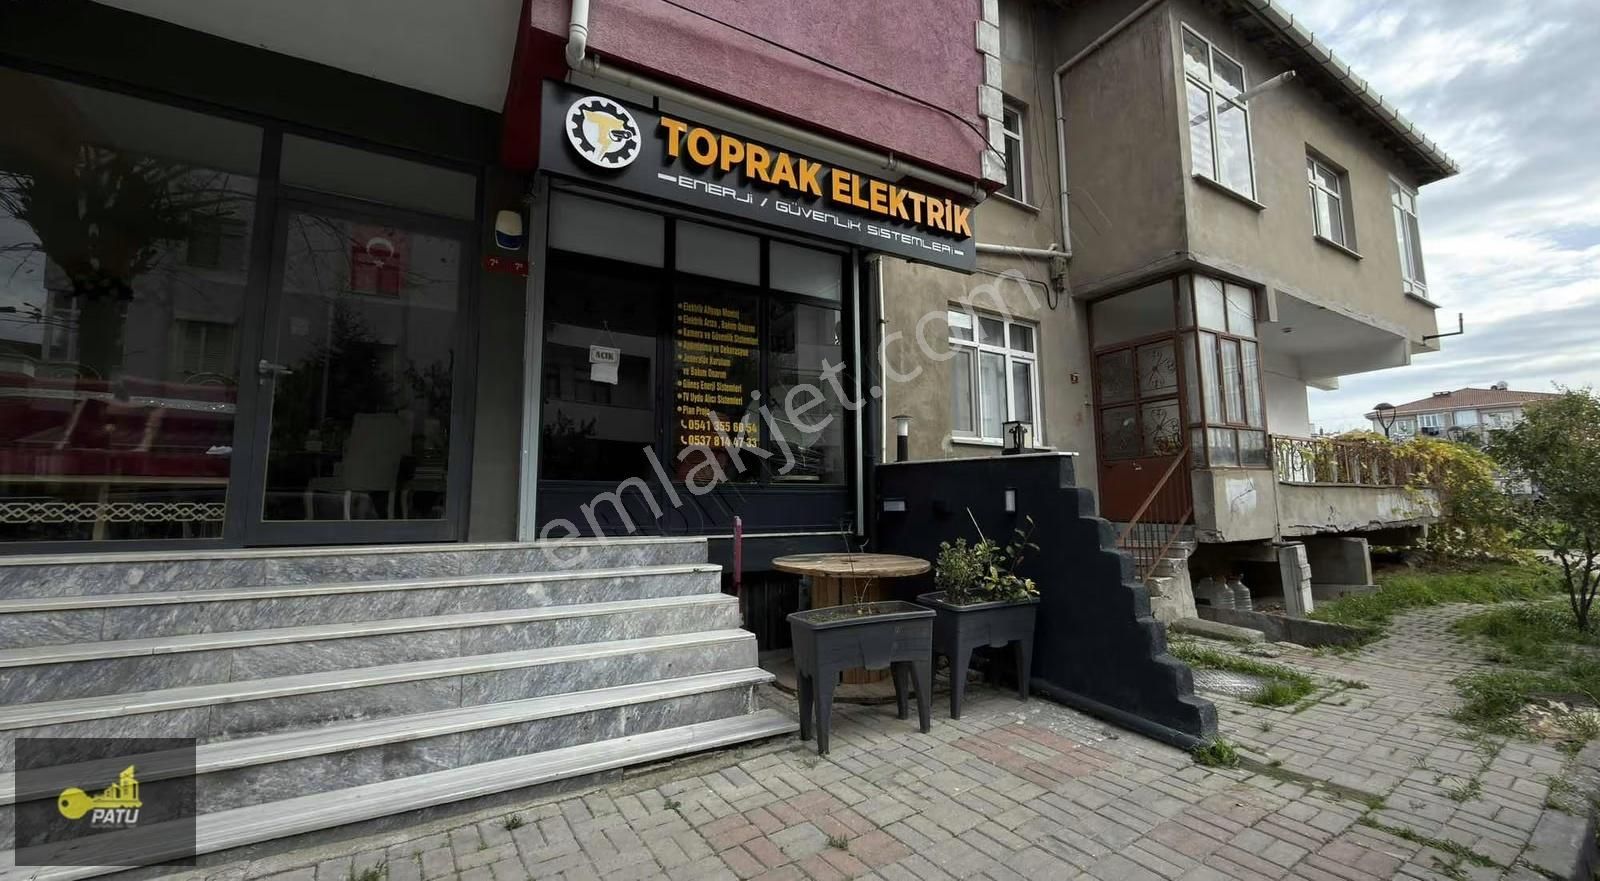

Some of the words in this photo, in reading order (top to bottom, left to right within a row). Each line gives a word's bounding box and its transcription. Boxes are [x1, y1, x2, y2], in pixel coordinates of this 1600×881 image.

[660, 116, 823, 198] TOPRAK
[831, 167, 972, 238] ELEKTRİK
[775, 201, 862, 232] GÜVENLİK
[683, 315, 703, 325] Elektrik
[700, 380, 716, 392] Enerji
[716, 382, 742, 393] Sistemleri
[682, 393, 689, 403] TV
[717, 396, 743, 406] Sistemleri
[682, 405, 695, 415] Plan
[688, 419, 711, 431] 0541
[714, 420, 731, 433] 355
[688, 434, 711, 446] 0537
[713, 435, 730, 448] 814
[746, 437, 758, 449] 33
